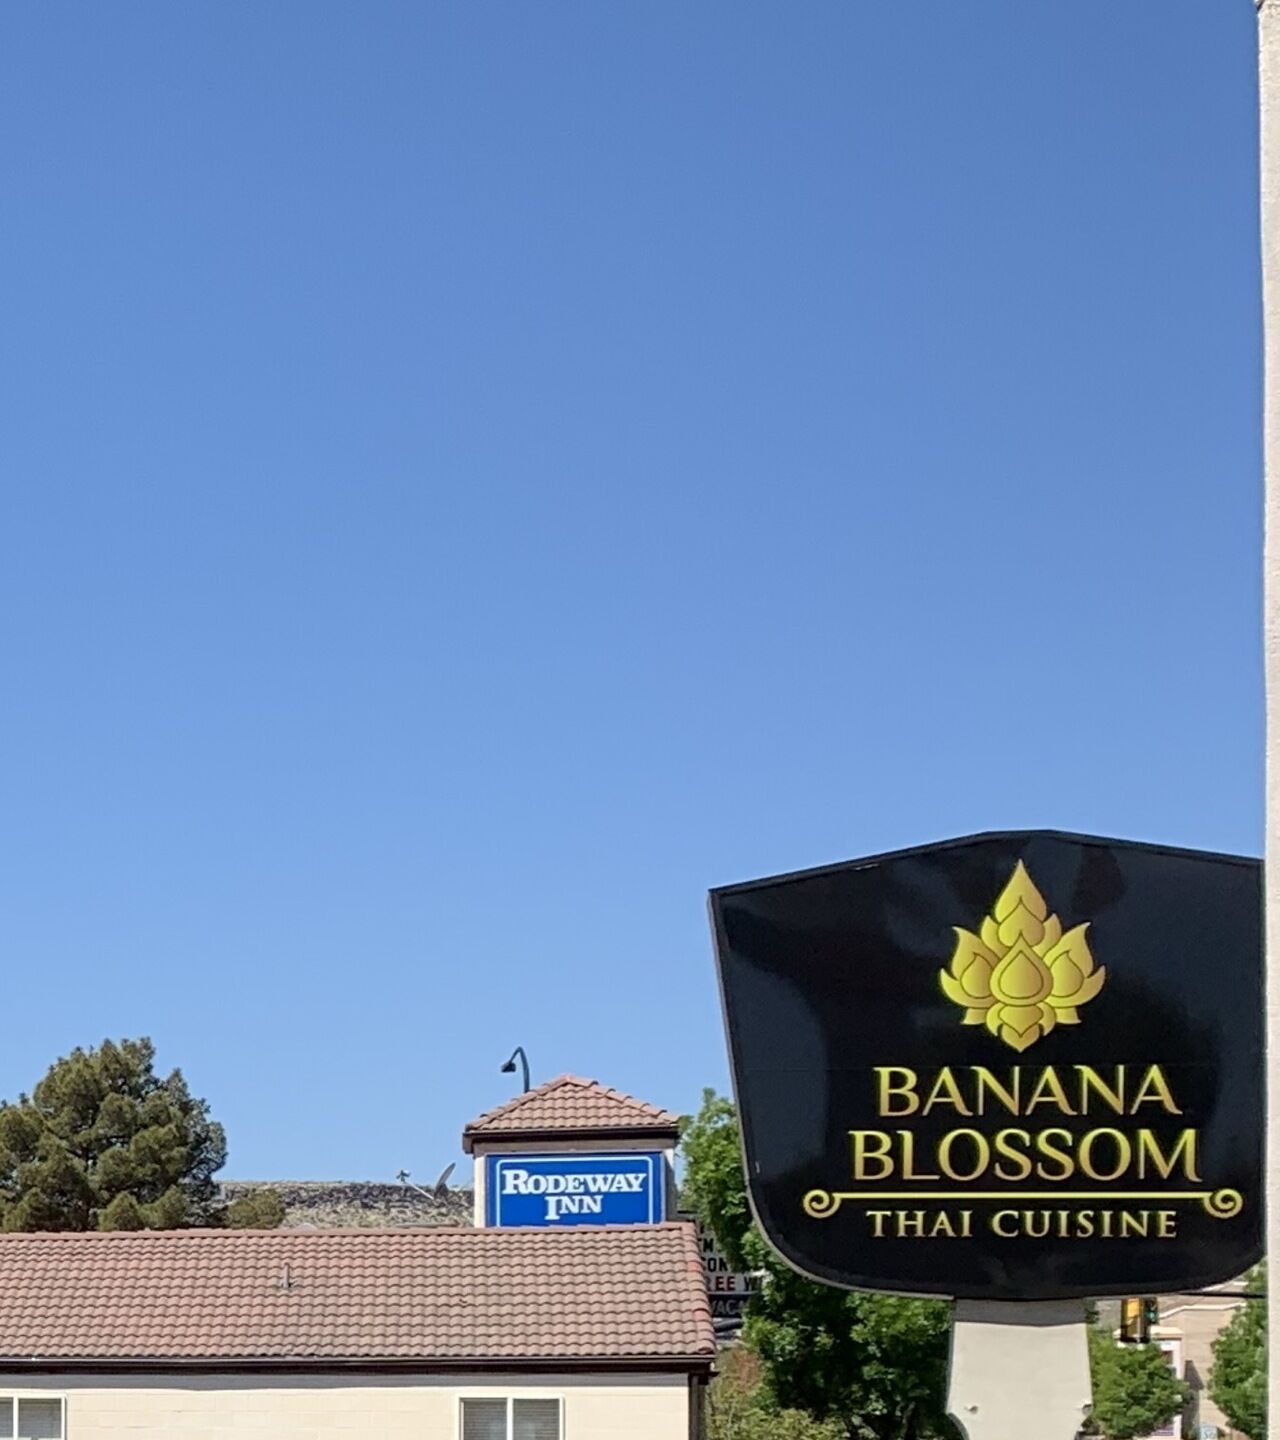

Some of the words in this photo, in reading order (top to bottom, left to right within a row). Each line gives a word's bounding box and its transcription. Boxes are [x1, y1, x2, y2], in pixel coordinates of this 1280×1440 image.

[873, 1064, 1183, 1117] BANANA
[847, 1128, 1203, 1183] BLOSSOM
[501, 1169, 648, 1195] RODEWAY
[544, 1195, 603, 1220] INN
[866, 1210, 973, 1238] THAI
[991, 1209, 1178, 1239] CUISINE
